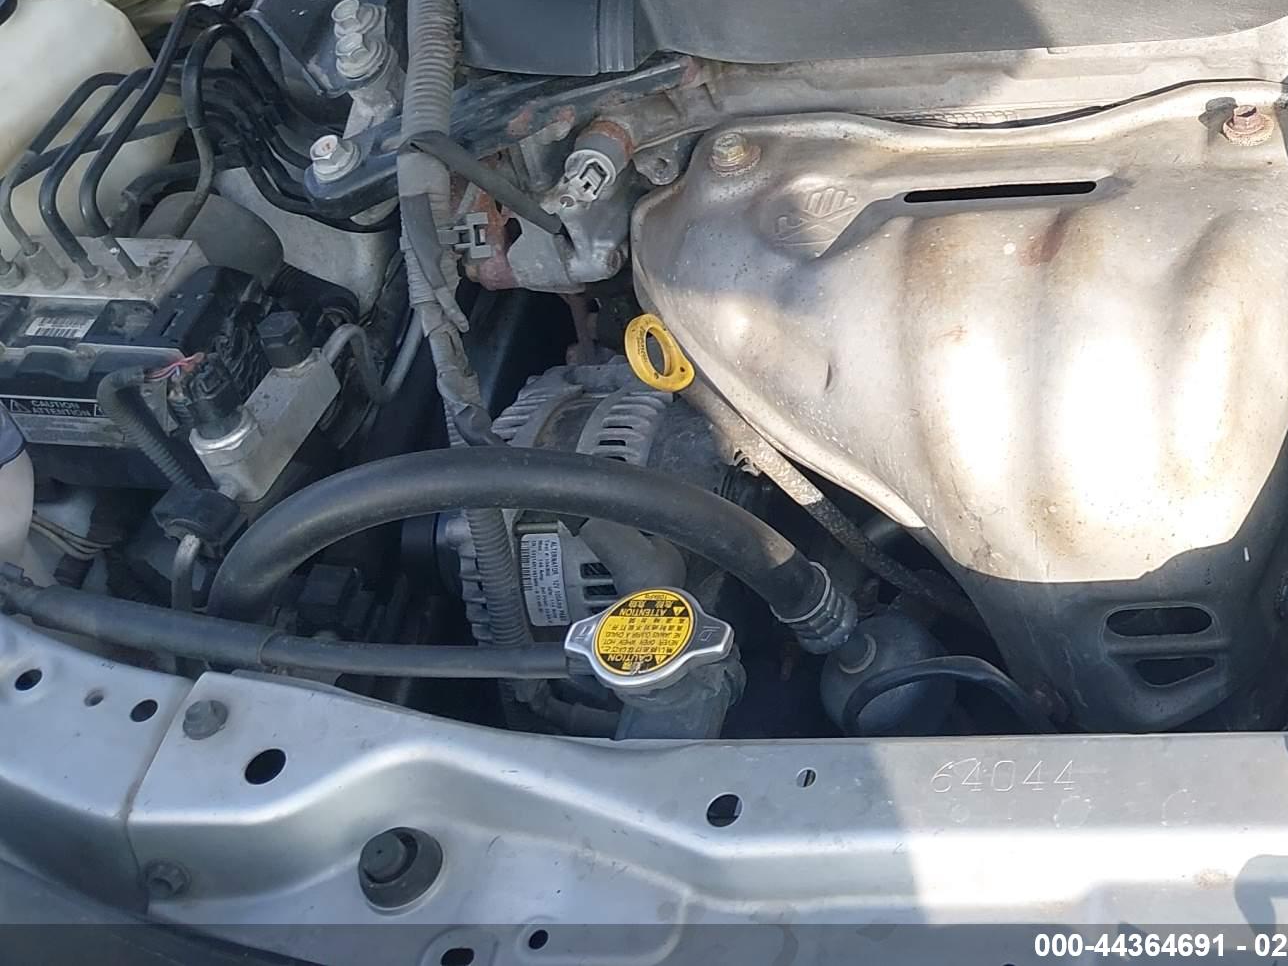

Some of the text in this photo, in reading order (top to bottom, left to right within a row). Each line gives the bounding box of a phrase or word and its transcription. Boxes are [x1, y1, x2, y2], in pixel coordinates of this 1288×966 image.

[30, 400, 81, 410] CAUTION
[31, 407, 92, 417] ATTENTION
[619, 607, 668, 616] ATTENTION
[607, 653, 653, 663] CAUTION
[929, 758, 1079, 793] 64044
